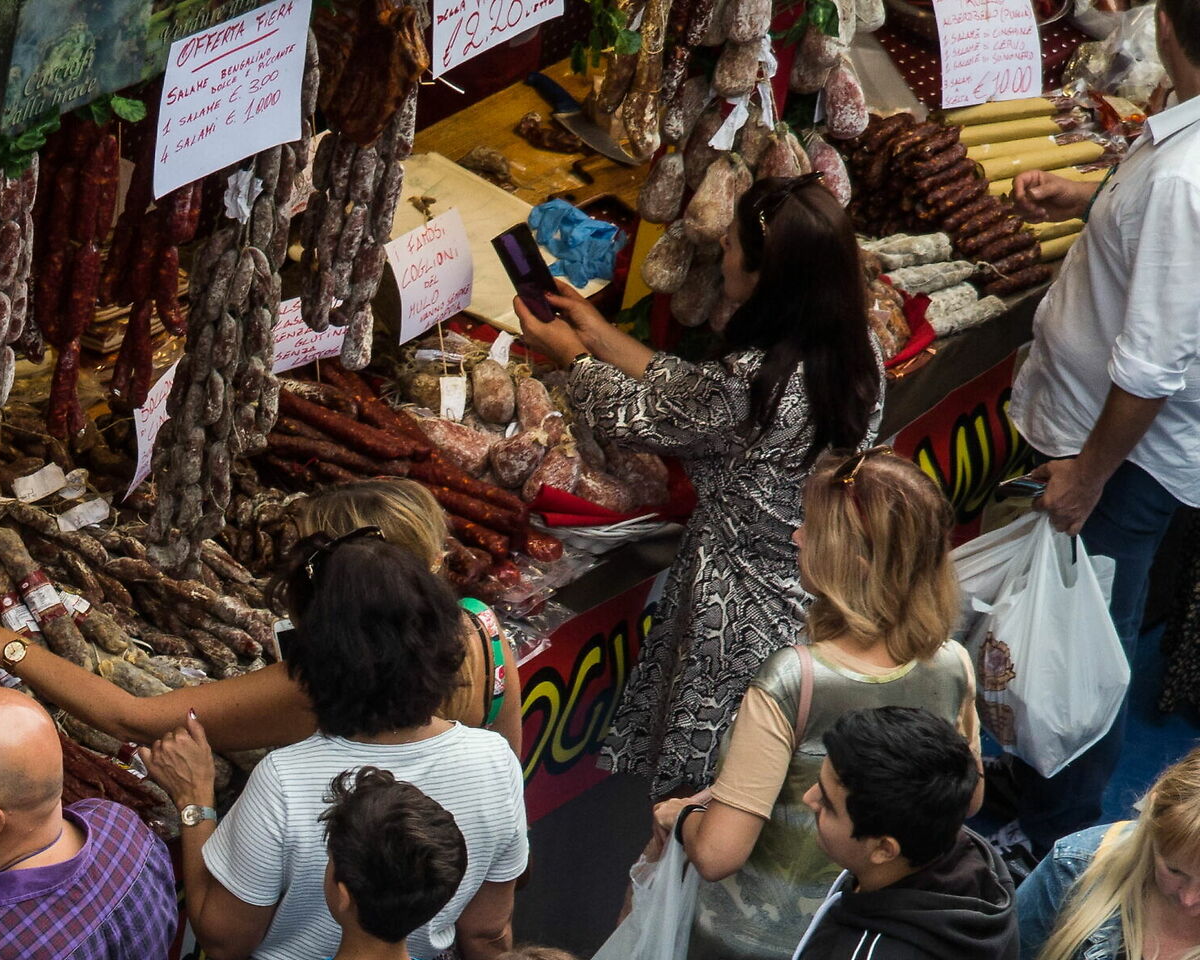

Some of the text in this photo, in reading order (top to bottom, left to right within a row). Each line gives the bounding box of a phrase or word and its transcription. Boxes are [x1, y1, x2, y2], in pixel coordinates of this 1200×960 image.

[177, 20, 245, 68] OFFERTA
[166, 78, 209, 105] SALAME
[179, 99, 222, 127] SALAME
[160, 145, 169, 164] 4
